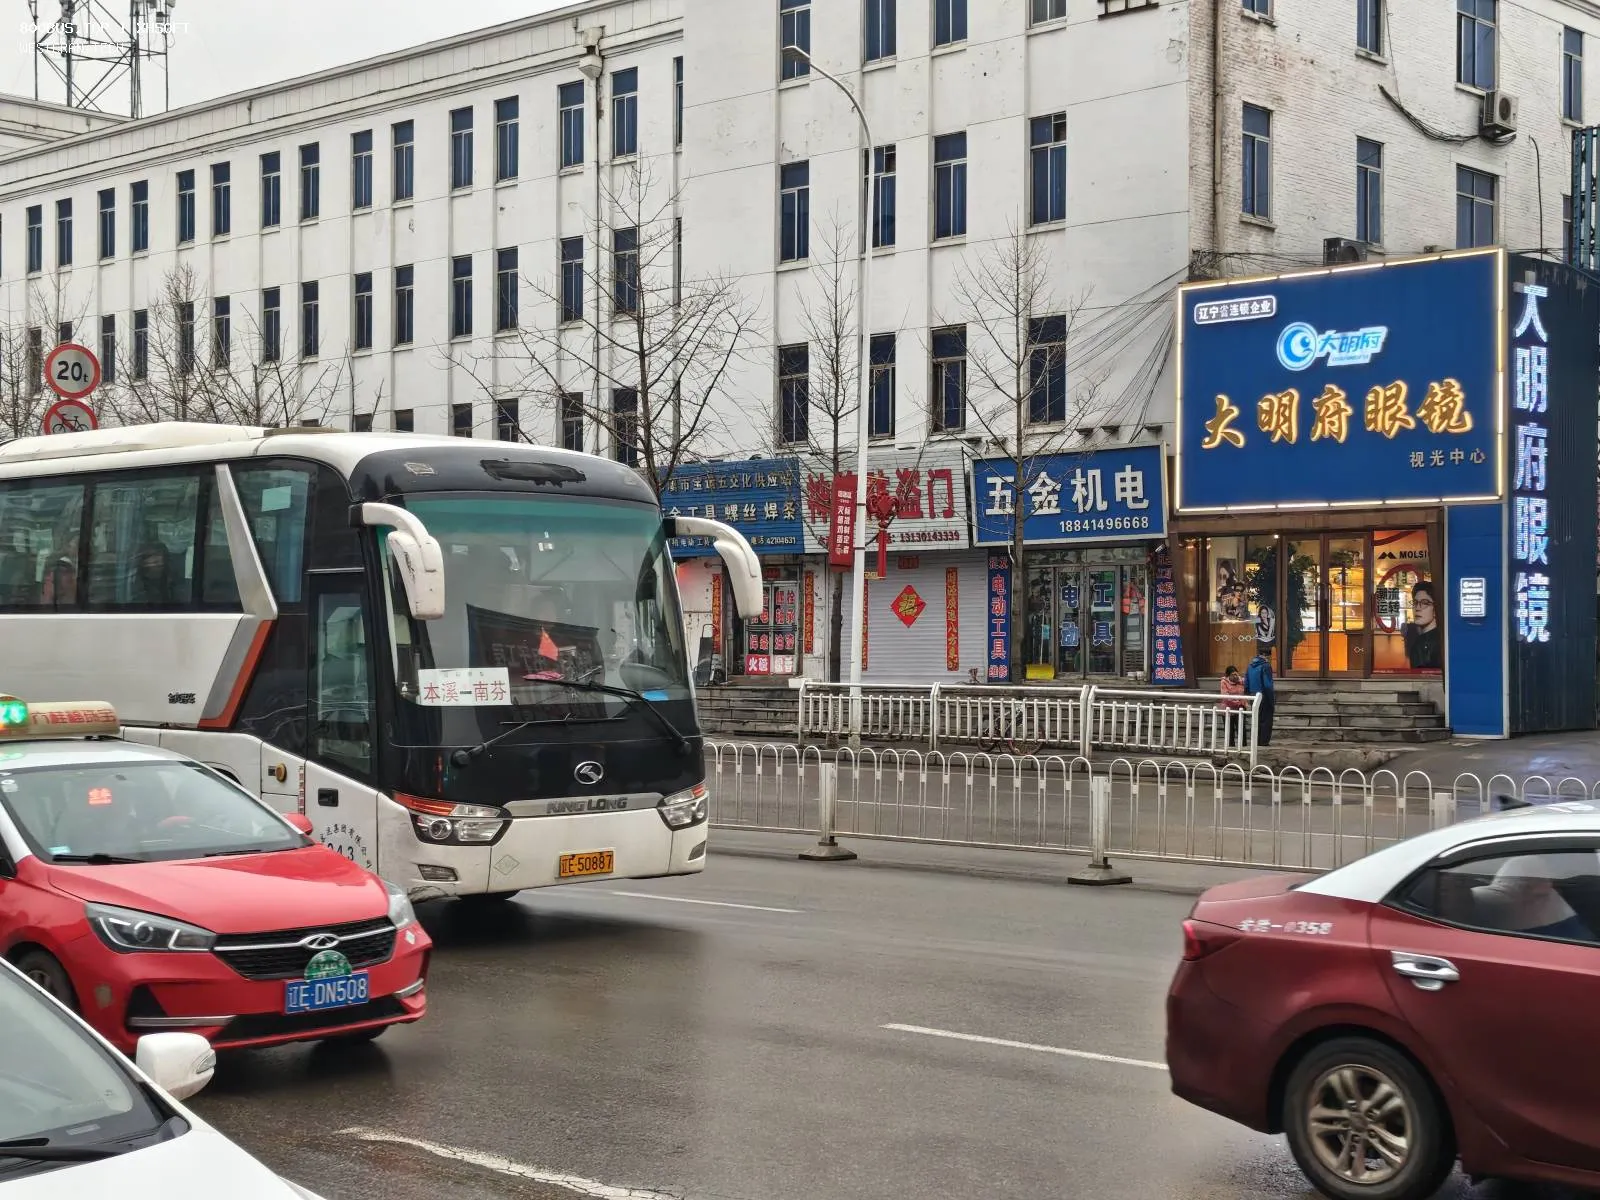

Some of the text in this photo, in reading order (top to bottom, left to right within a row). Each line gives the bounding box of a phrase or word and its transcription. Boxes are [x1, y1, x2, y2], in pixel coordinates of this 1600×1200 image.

[1198, 300, 1271, 320] 辽宁省连锁企业
[1318, 330, 1382, 353] 大明府
[57, 361, 89, 382] 20t
[1201, 379, 1475, 450] 大明府眼镜
[1409, 448, 1487, 469] 视光中心
[1513, 271, 1550, 643] 大明府眼镜
[985, 464, 1150, 516] 五金机电
[725, 503, 758, 522] 螺丝
[765, 500, 797, 521] 焊条
[1059, 516, 1150, 533] 18841496668
[991, 573, 1007, 660] 电动工具
[547, 797, 628, 814] KING LONG
